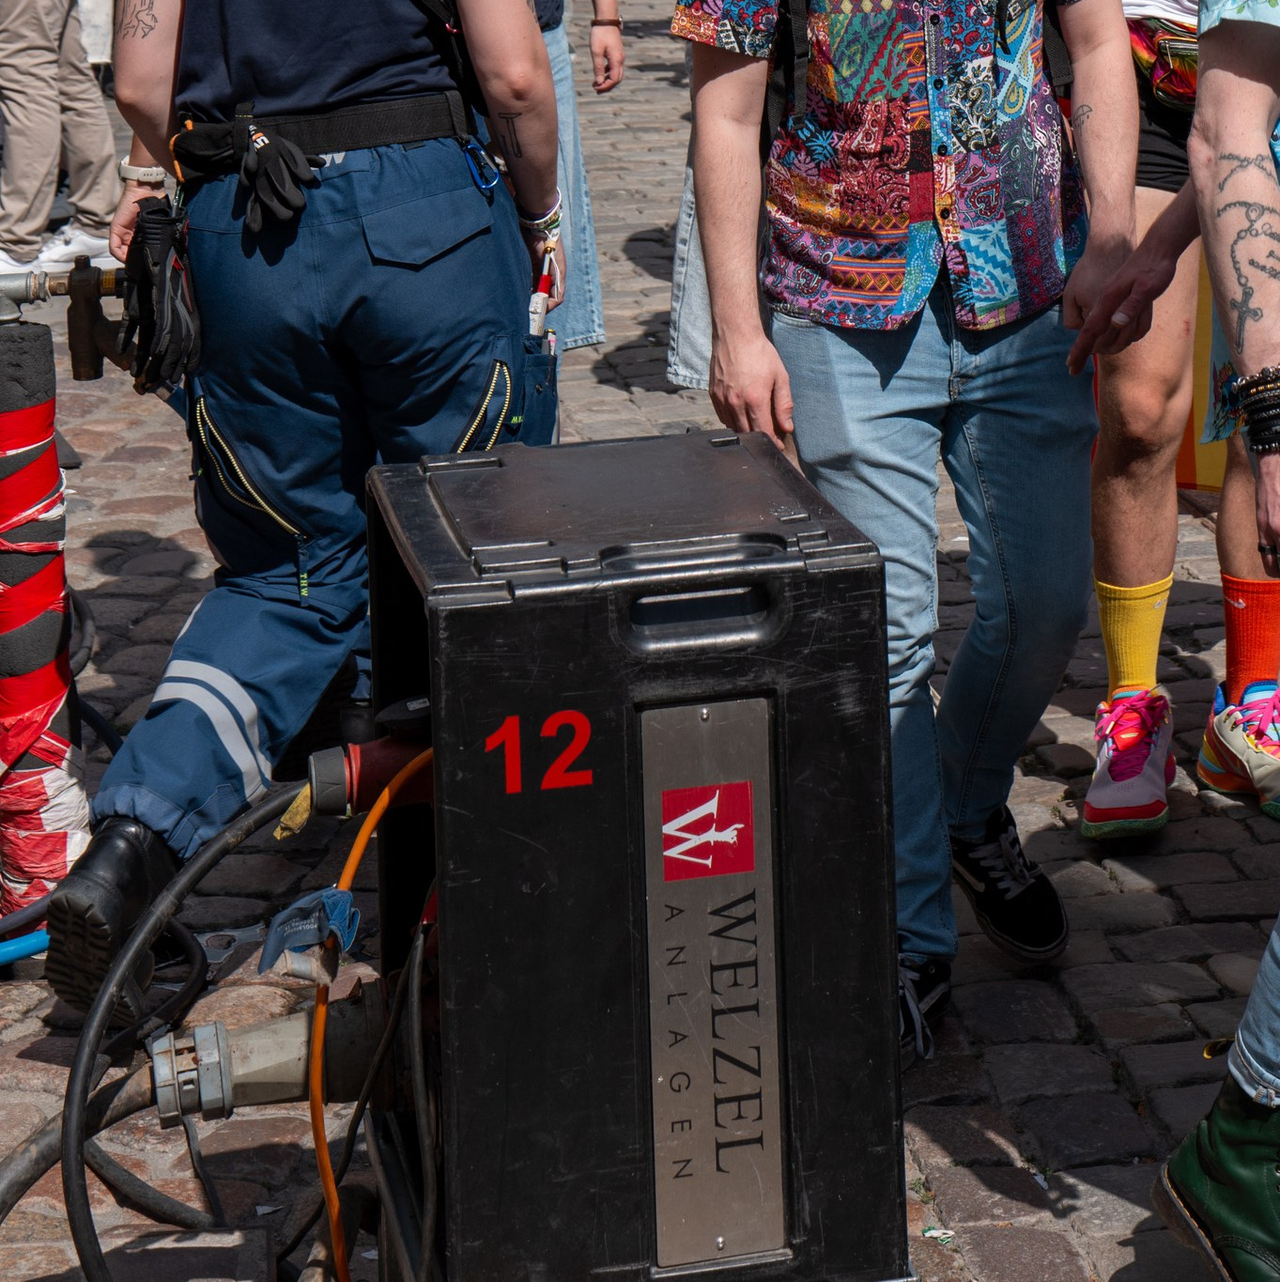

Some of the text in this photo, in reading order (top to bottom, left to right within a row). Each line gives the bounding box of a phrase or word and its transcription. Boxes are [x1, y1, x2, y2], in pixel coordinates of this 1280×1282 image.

[300, 572, 308, 596] THW
[484, 709, 594, 795] 12
[664, 903, 694, 1180] ANLAGEN
[707, 887, 764, 1175] WELZEL
